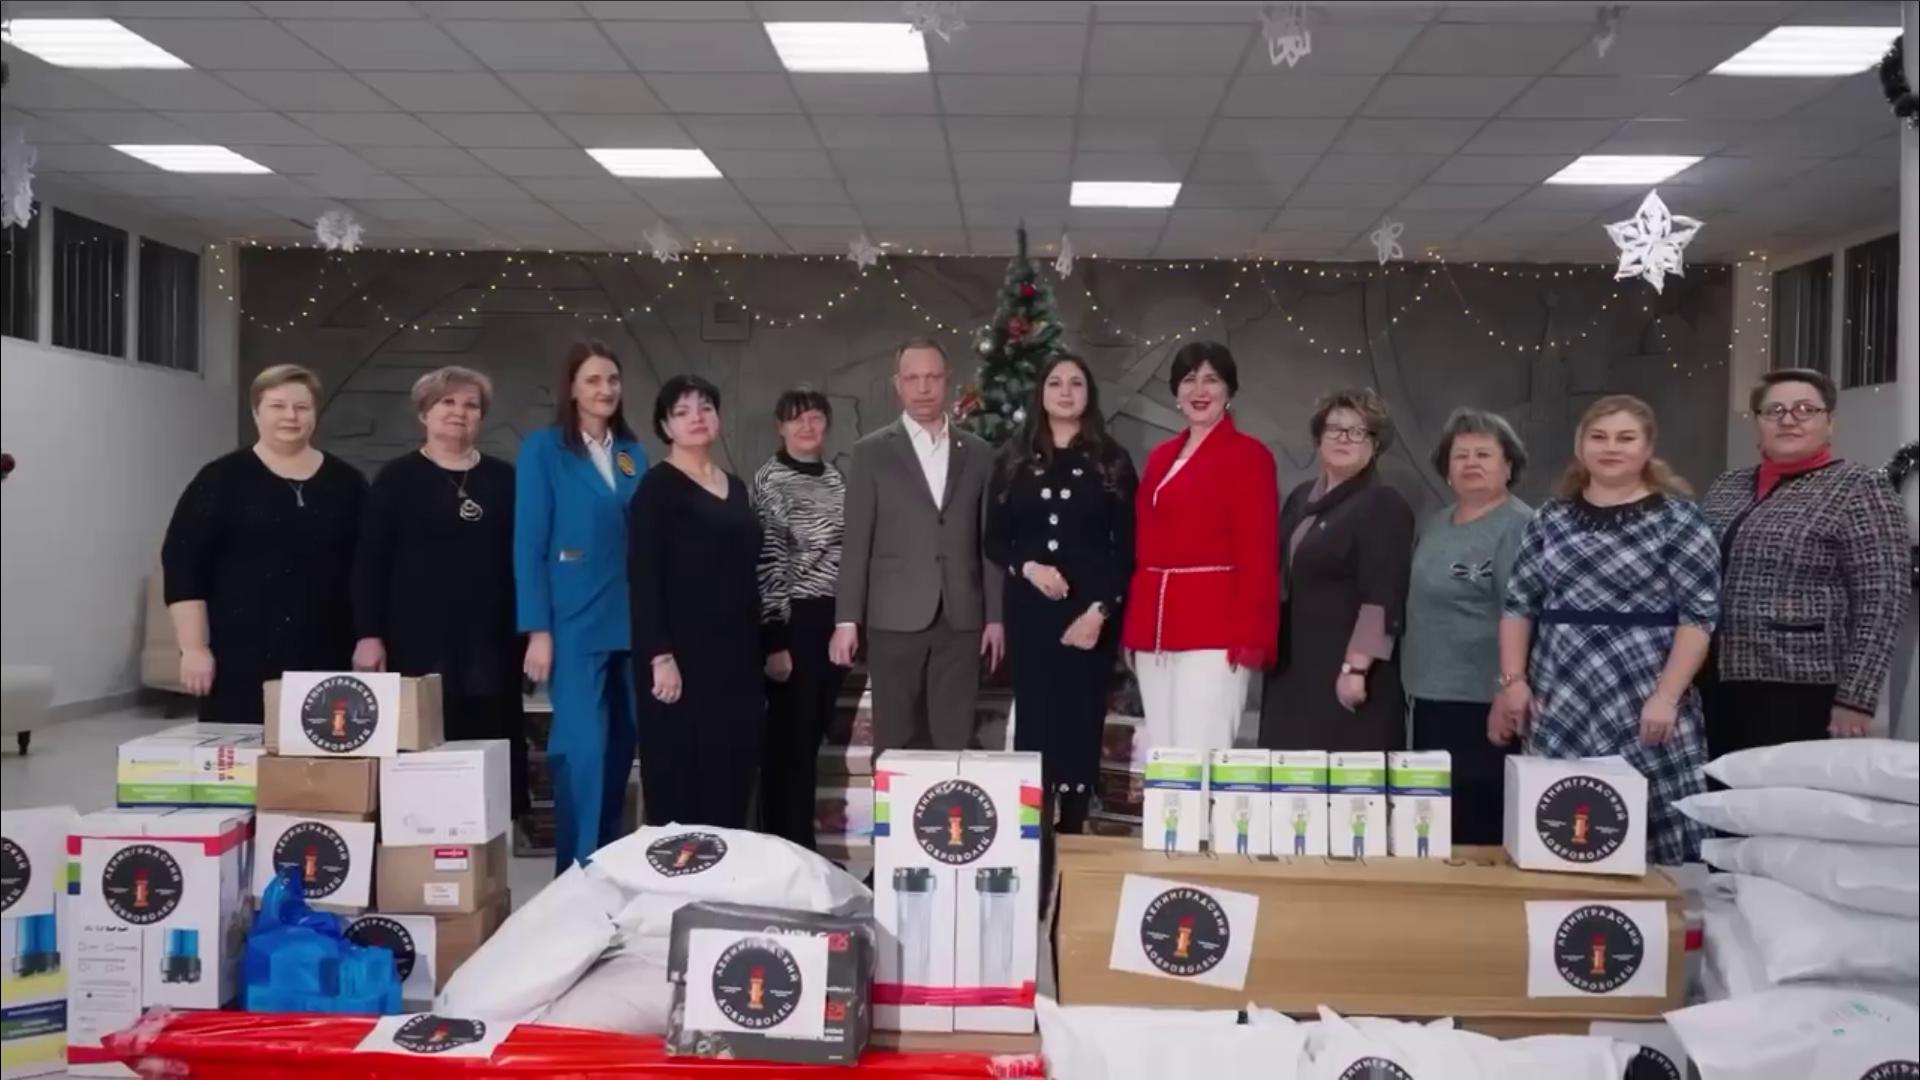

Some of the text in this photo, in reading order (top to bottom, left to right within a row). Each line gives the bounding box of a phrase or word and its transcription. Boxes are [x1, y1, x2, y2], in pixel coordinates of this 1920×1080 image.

[1540, 778, 1626, 821] ЛЕНИНГРАДСКИЙ
[920, 836, 990, 862] ДОБРОВОЛЕЦ
[1541, 831, 1618, 860] ДОБРОВОЛЕЦ
[1146, 890, 1227, 936] ЛЕНИНГРАДСКИЙ
[1557, 907, 1640, 947] ЛЕНИНГРАДСКИЙ
[1145, 943, 1218, 973] ДОБРОВОЛЕЦ
[1560, 964, 1634, 990] ДОБРОВОЛЕЦ
[718, 998, 792, 1027] ДОБРОВОЛЕЦ
